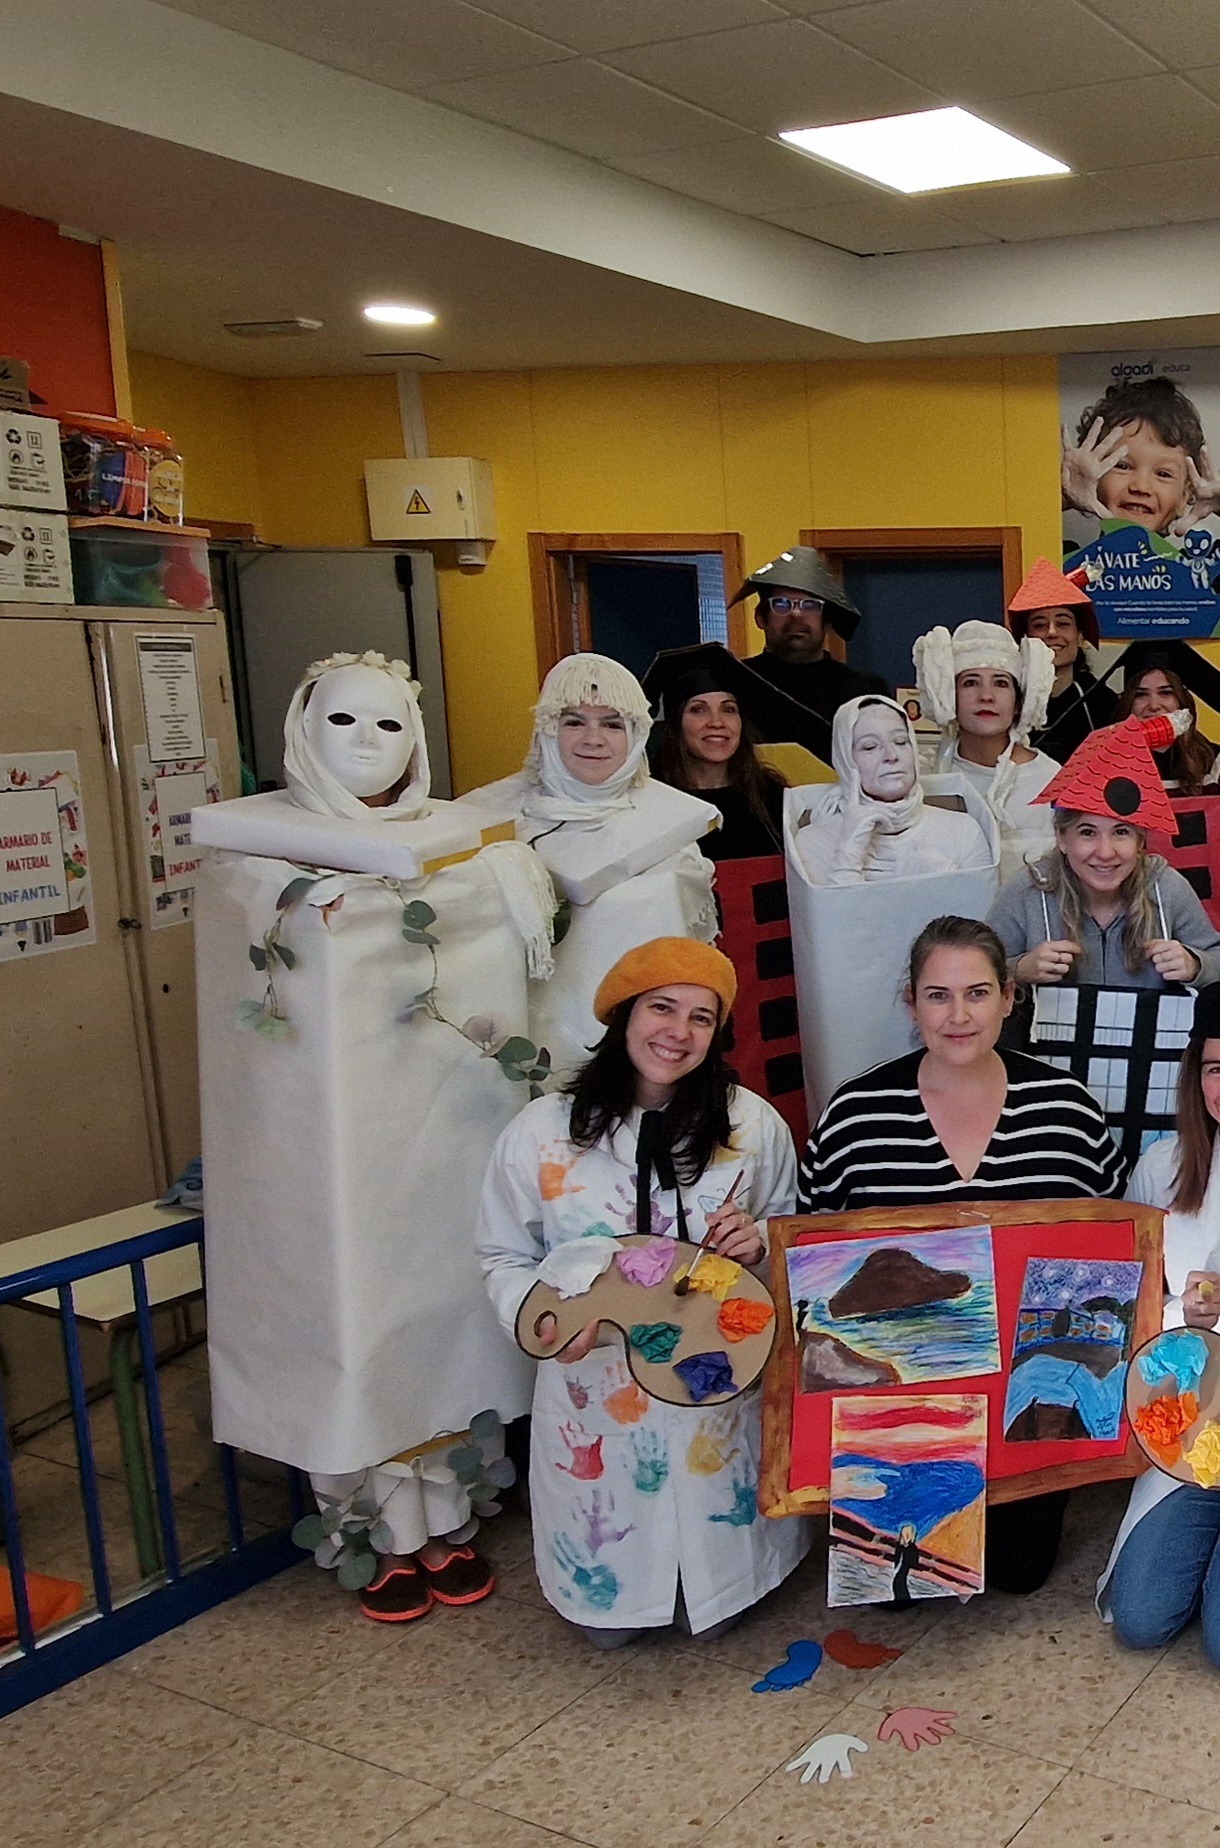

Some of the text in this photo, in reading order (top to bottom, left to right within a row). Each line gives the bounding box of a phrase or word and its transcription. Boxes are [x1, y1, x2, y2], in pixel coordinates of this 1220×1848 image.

[1119, 574, 1172, 592] MANOS
[41, 831, 52, 845] DE
[174, 833, 192, 847] MATE
[6, 855, 50, 872] MATERIAL
[168, 859, 202, 876] INFANT
